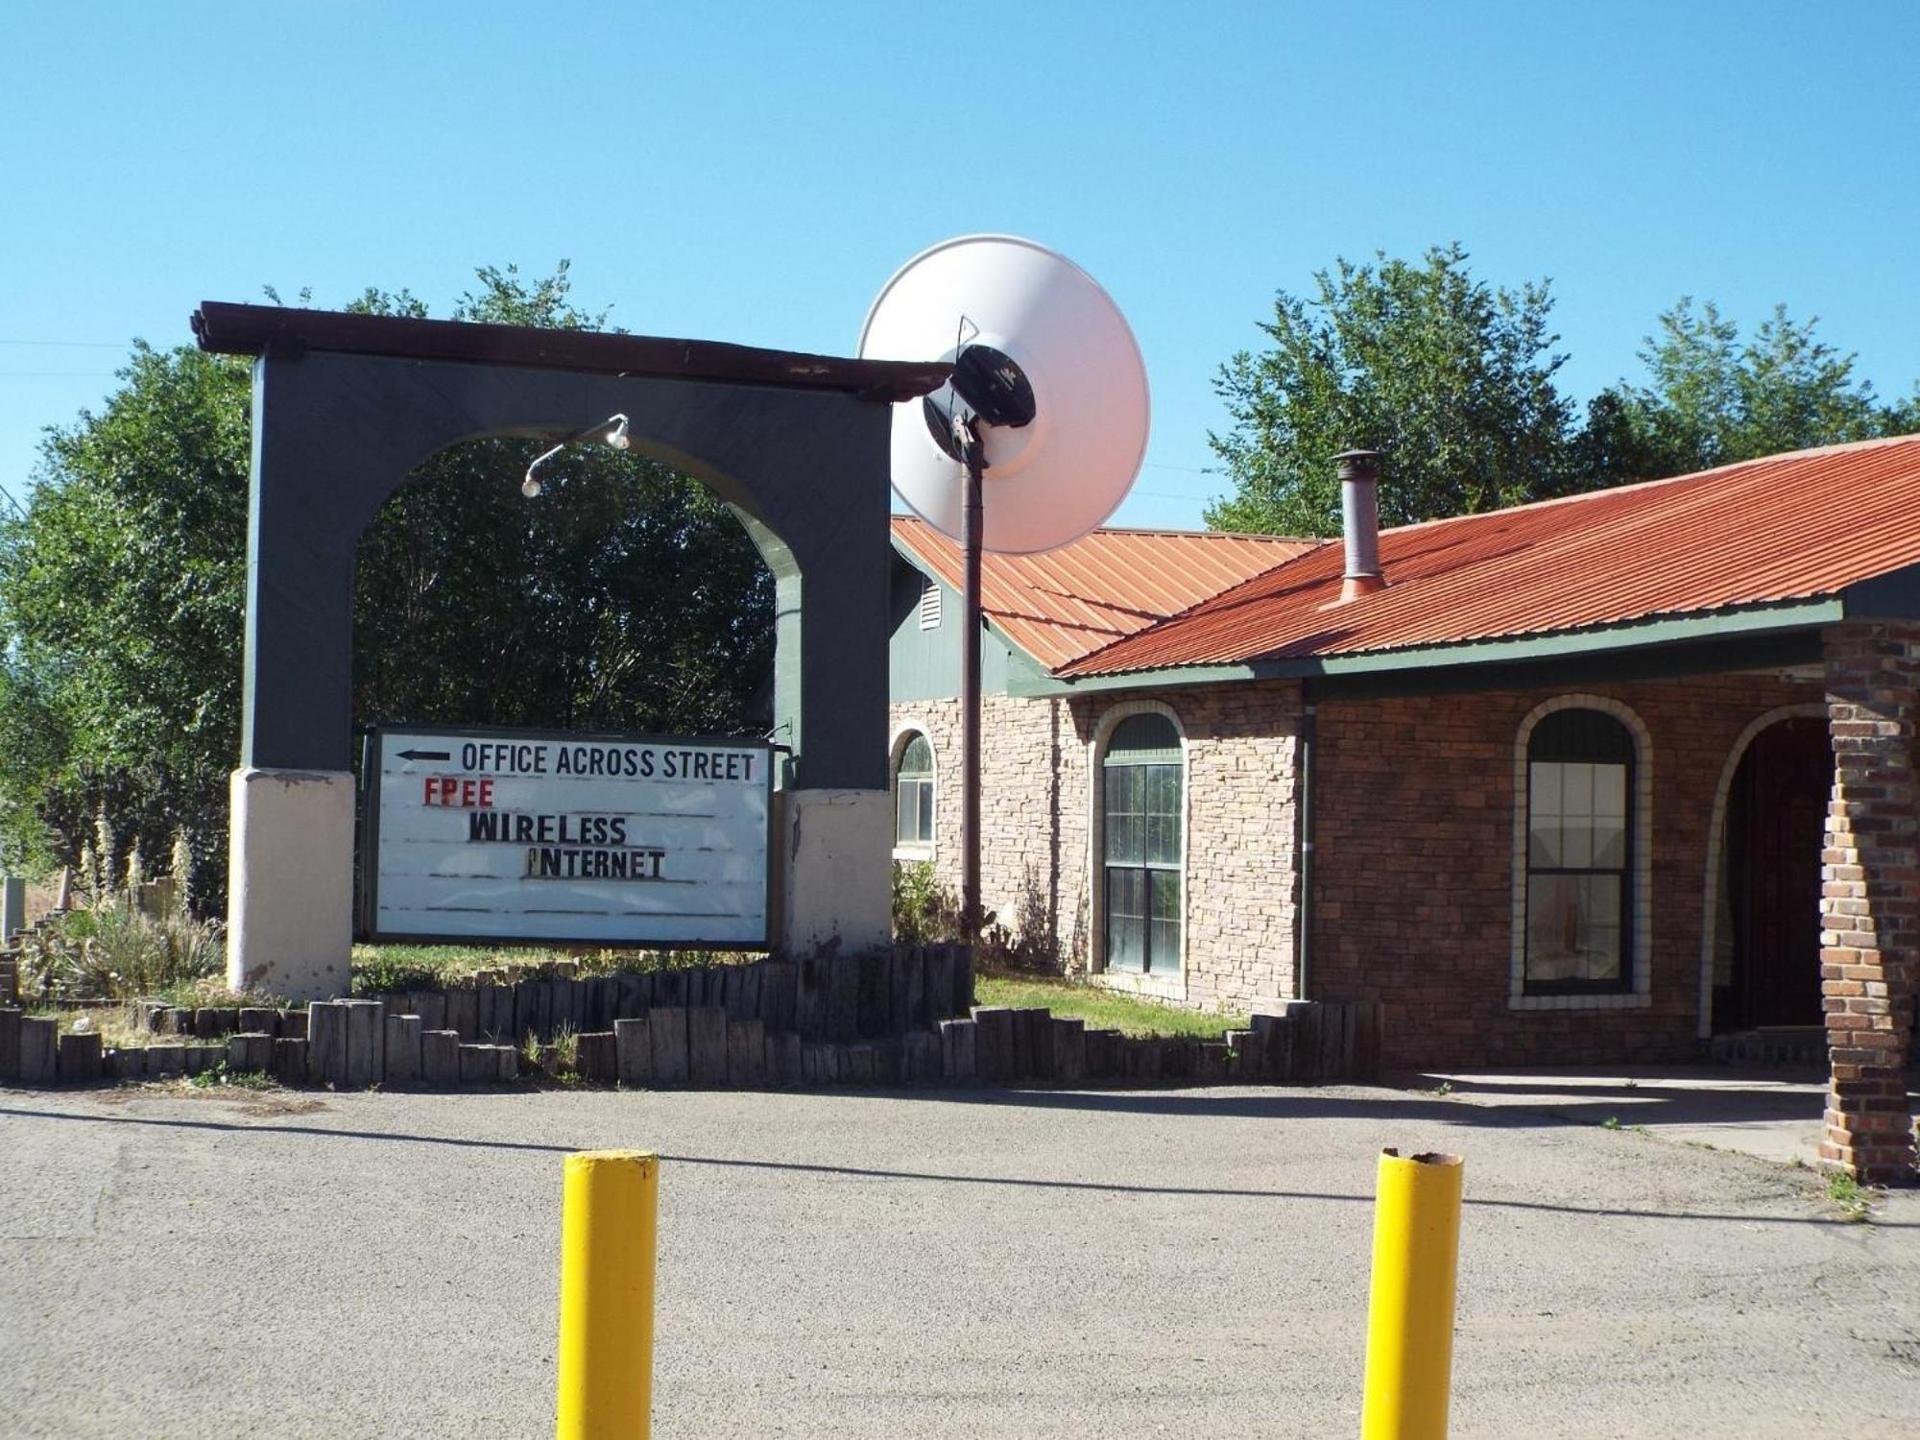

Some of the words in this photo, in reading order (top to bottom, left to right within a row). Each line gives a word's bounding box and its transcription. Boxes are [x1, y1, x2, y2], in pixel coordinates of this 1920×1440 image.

[462, 742, 548, 774] OFFICE
[556, 747, 655, 777] ACROSS
[663, 751, 755, 781] STREET
[469, 812, 626, 844] WIRELESS
[528, 847, 665, 878] INTERNET
